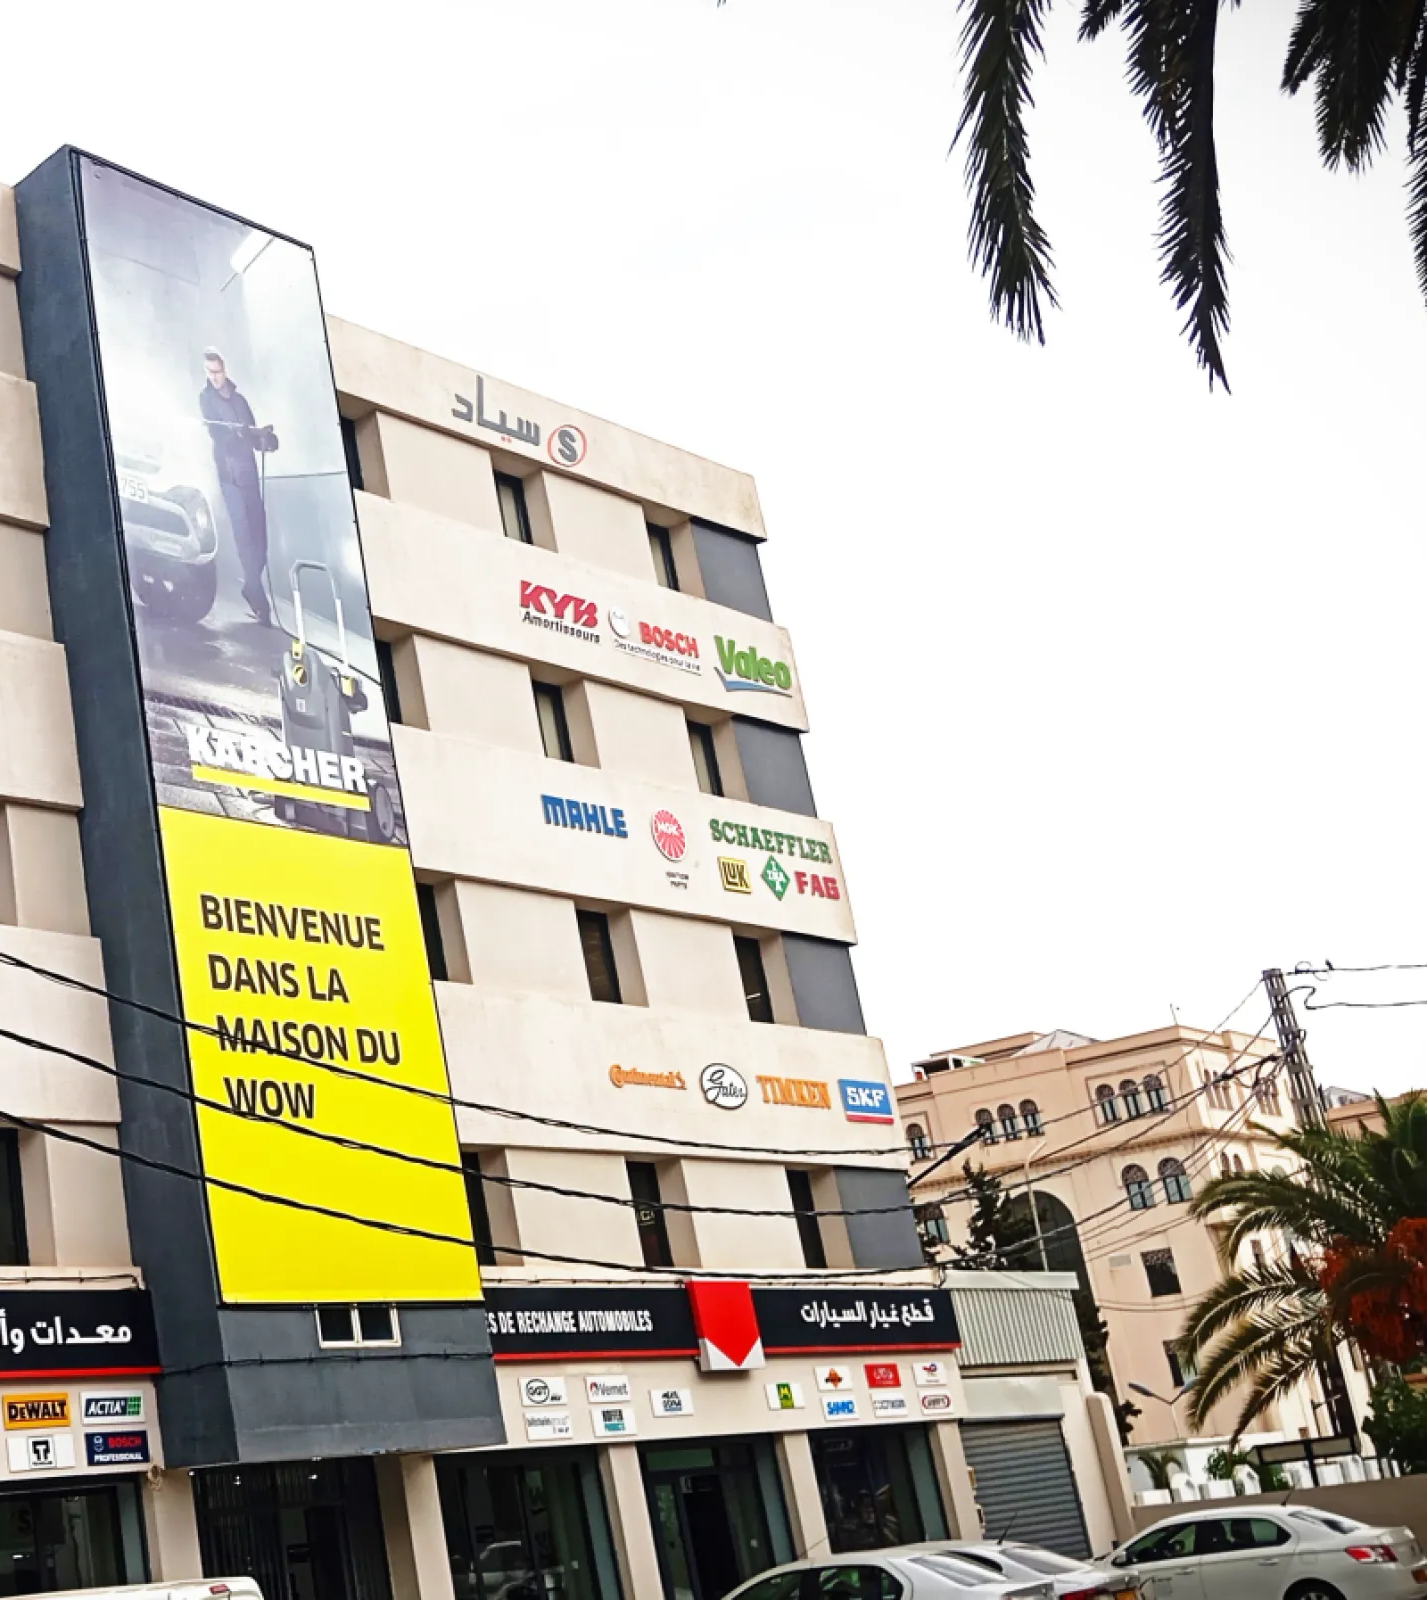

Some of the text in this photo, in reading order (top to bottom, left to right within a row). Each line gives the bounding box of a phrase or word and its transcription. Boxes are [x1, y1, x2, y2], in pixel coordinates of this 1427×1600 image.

[451, 374, 540, 446] سياد
[520, 580, 598, 628] KYB
[639, 622, 699, 658] BOSCH
[714, 635, 791, 689] Valeo
[540, 794, 628, 838] MAHLE
[710, 818, 833, 864] SCHAEFFLER
[795, 871, 840, 900] FAG
[200, 894, 385, 951] BIENVENUE
[208, 954, 350, 1003] DANS LA
[216, 1014, 401, 1066] MAISON DU
[223, 1077, 314, 1119] WOW
[756, 1074, 831, 1109] TIMKEN
[846, 1086, 885, 1107] SKF
[30, 1315, 132, 1345] معدات
[498, 1311, 516, 1333] DE
[516, 1311, 577, 1333] RECHANGE
[578, 1309, 654, 1332] AUTOMOBILES
[800, 1298, 934, 1329] قطع غيار السيارات
[88, 1400, 122, 1416] ACTIA
[94, 1452, 143, 1462] PROFESSIONAL
[108, 1436, 142, 1448] BOSCH
